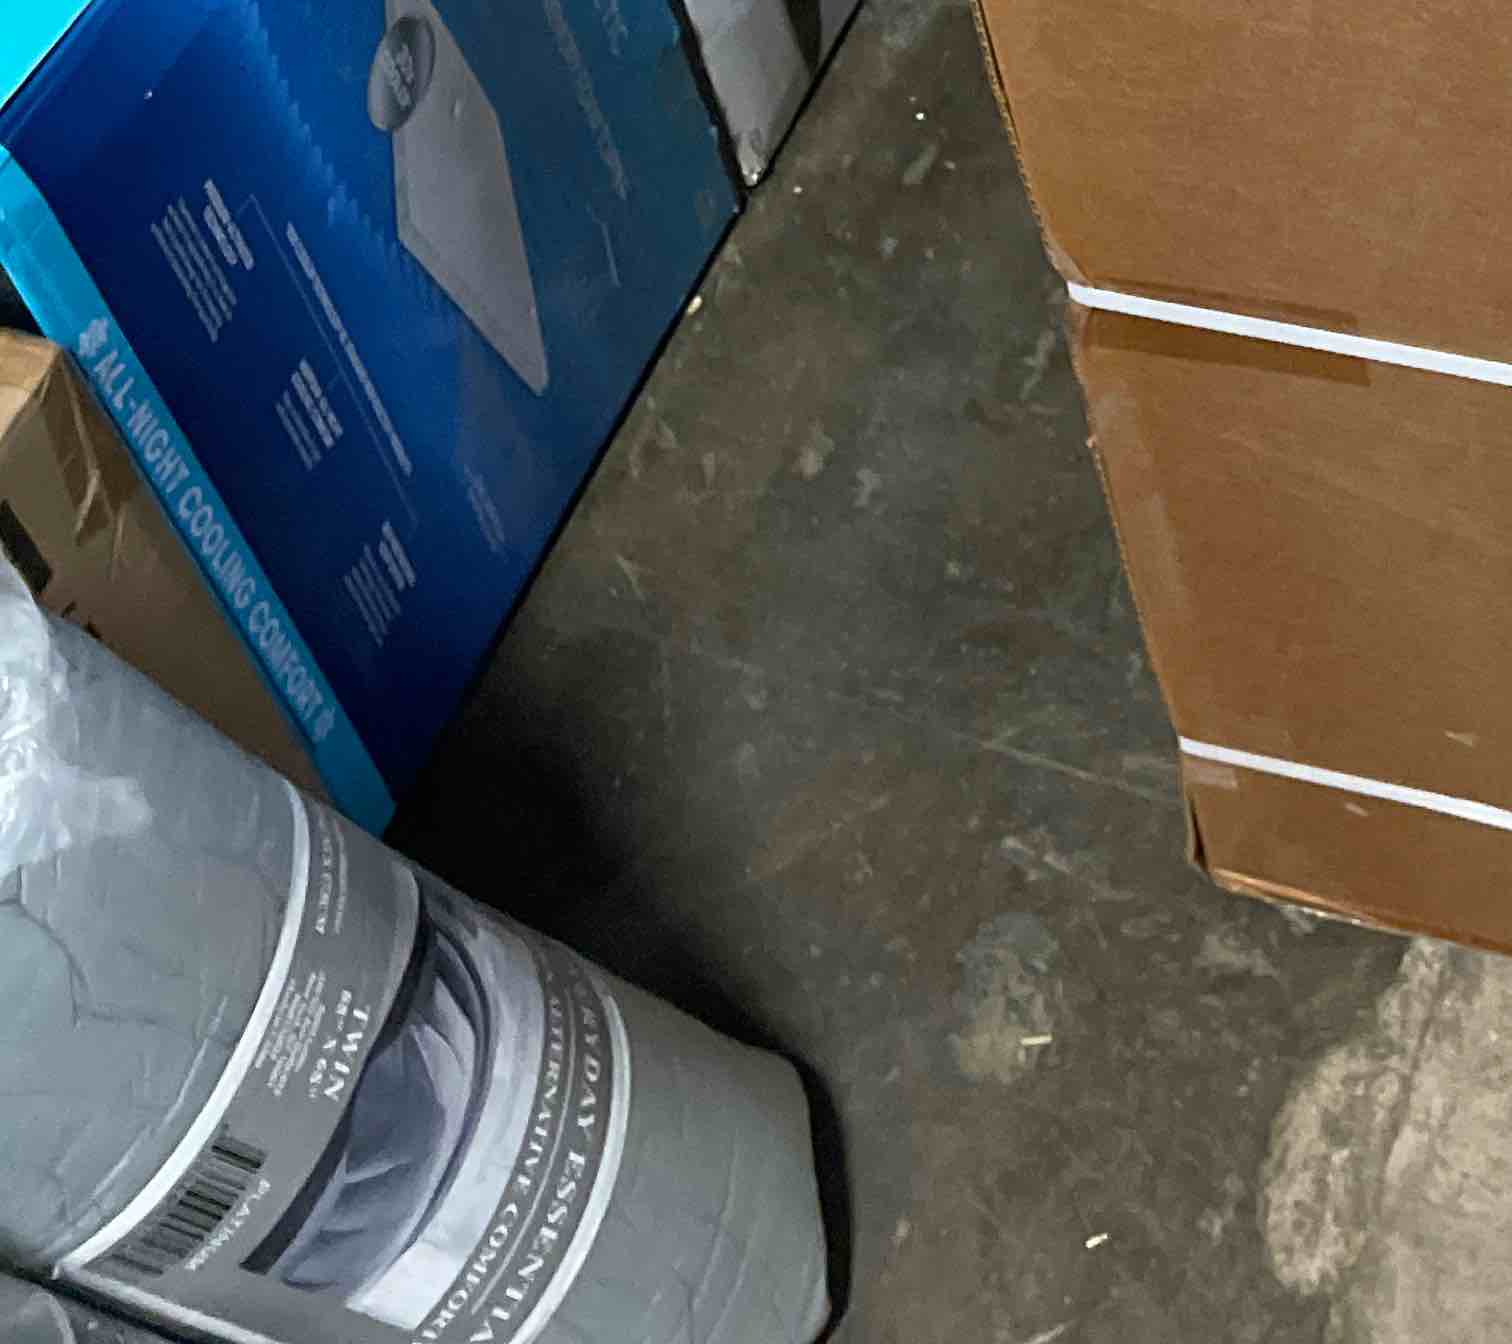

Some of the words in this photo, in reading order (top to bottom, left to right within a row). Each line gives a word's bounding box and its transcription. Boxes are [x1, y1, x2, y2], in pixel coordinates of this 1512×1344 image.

[93, 349, 191, 494] ALL-NIGHT
[178, 485, 257, 610] COOLING
[248, 600, 326, 723] COMFORT
[324, 1004, 370, 1102] TWIN
